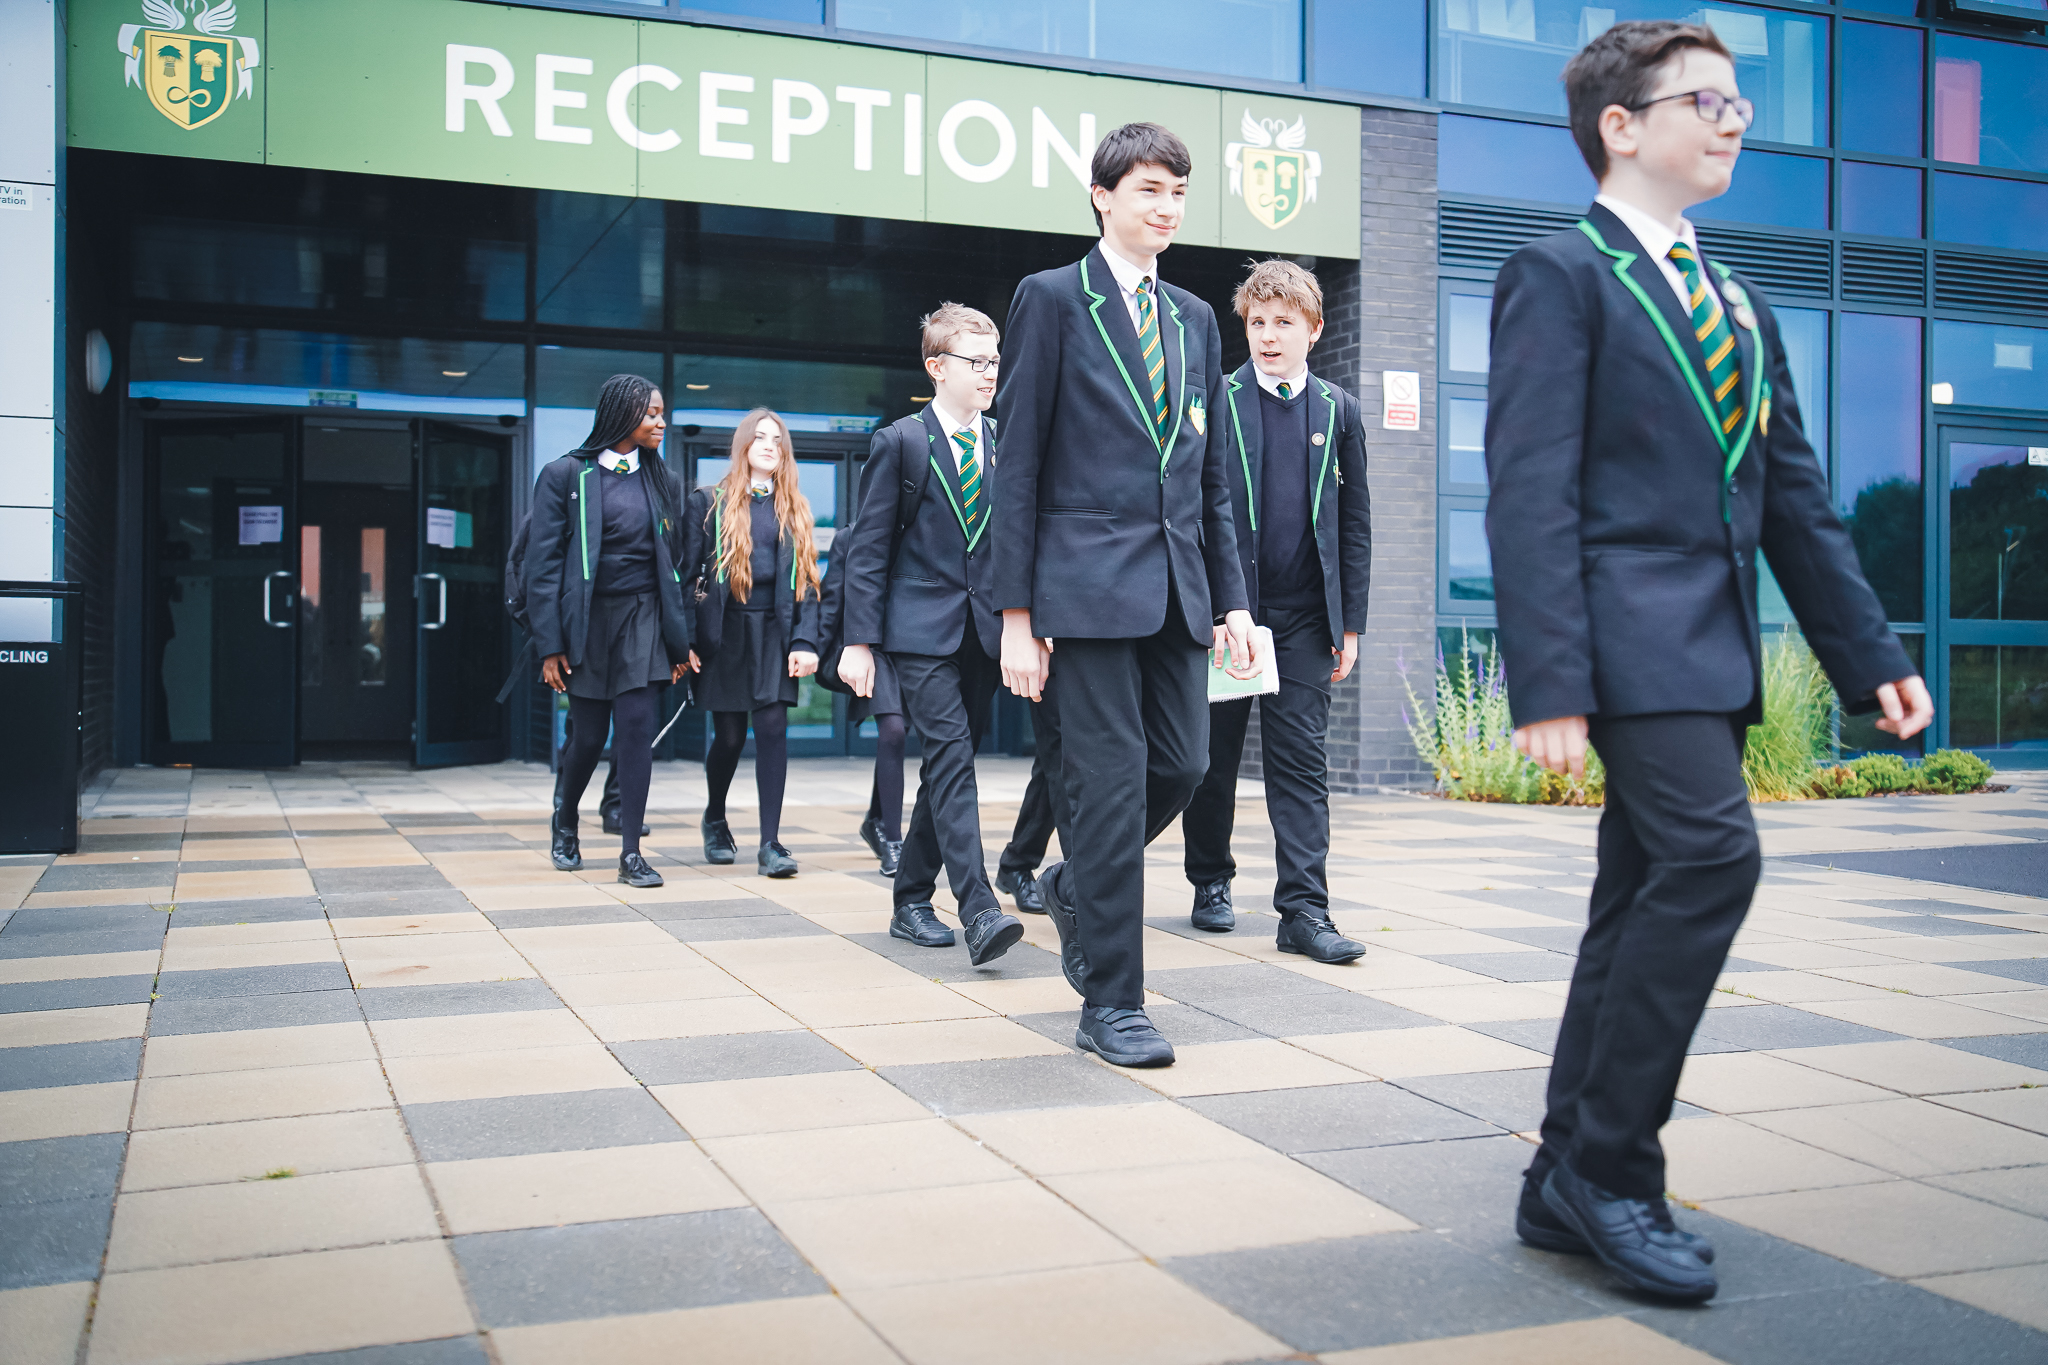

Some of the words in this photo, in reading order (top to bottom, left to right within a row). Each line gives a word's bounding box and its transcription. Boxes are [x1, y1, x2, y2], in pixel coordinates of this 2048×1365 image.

[445, 43, 1096, 193] RECEPTION
[13, 187, 23, 196] in
[0, 196, 27, 206] ation
[0, 650, 49, 664] CLING
